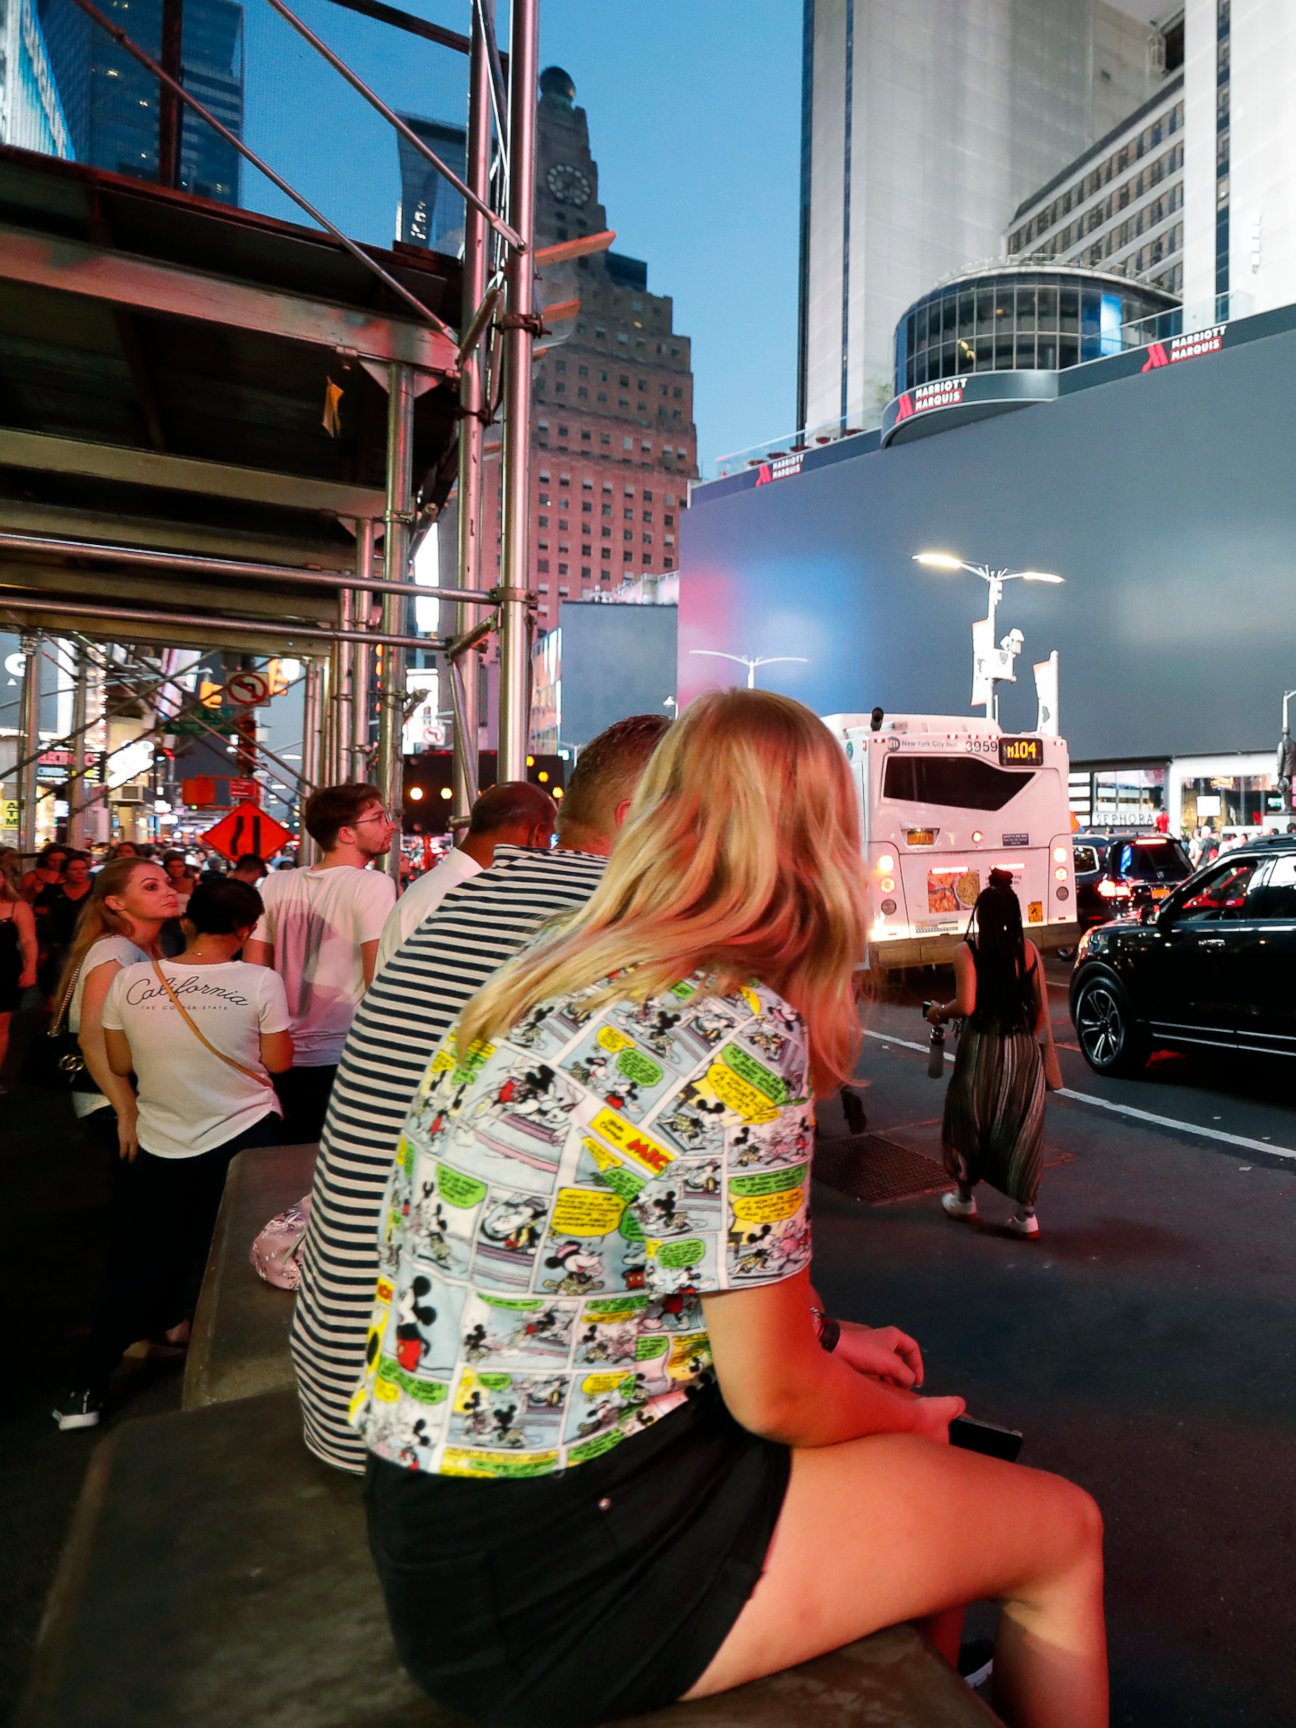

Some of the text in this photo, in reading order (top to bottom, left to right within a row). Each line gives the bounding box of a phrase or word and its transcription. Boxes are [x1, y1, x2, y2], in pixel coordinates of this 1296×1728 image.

[1171, 325, 1227, 350] MARRIOTT
[1171, 338, 1220, 361] MARQUIS
[915, 377, 968, 400] MARRIOTT
[914, 390, 961, 412] MARQUIS
[902, 740, 916, 748] New
[916, 740, 930, 748] York
[931, 740, 945, 749] City
[965, 740, 998, 752] 3959
[1007, 741, 1037, 759] M104
[1096, 813, 1154, 826] SEPHORA
